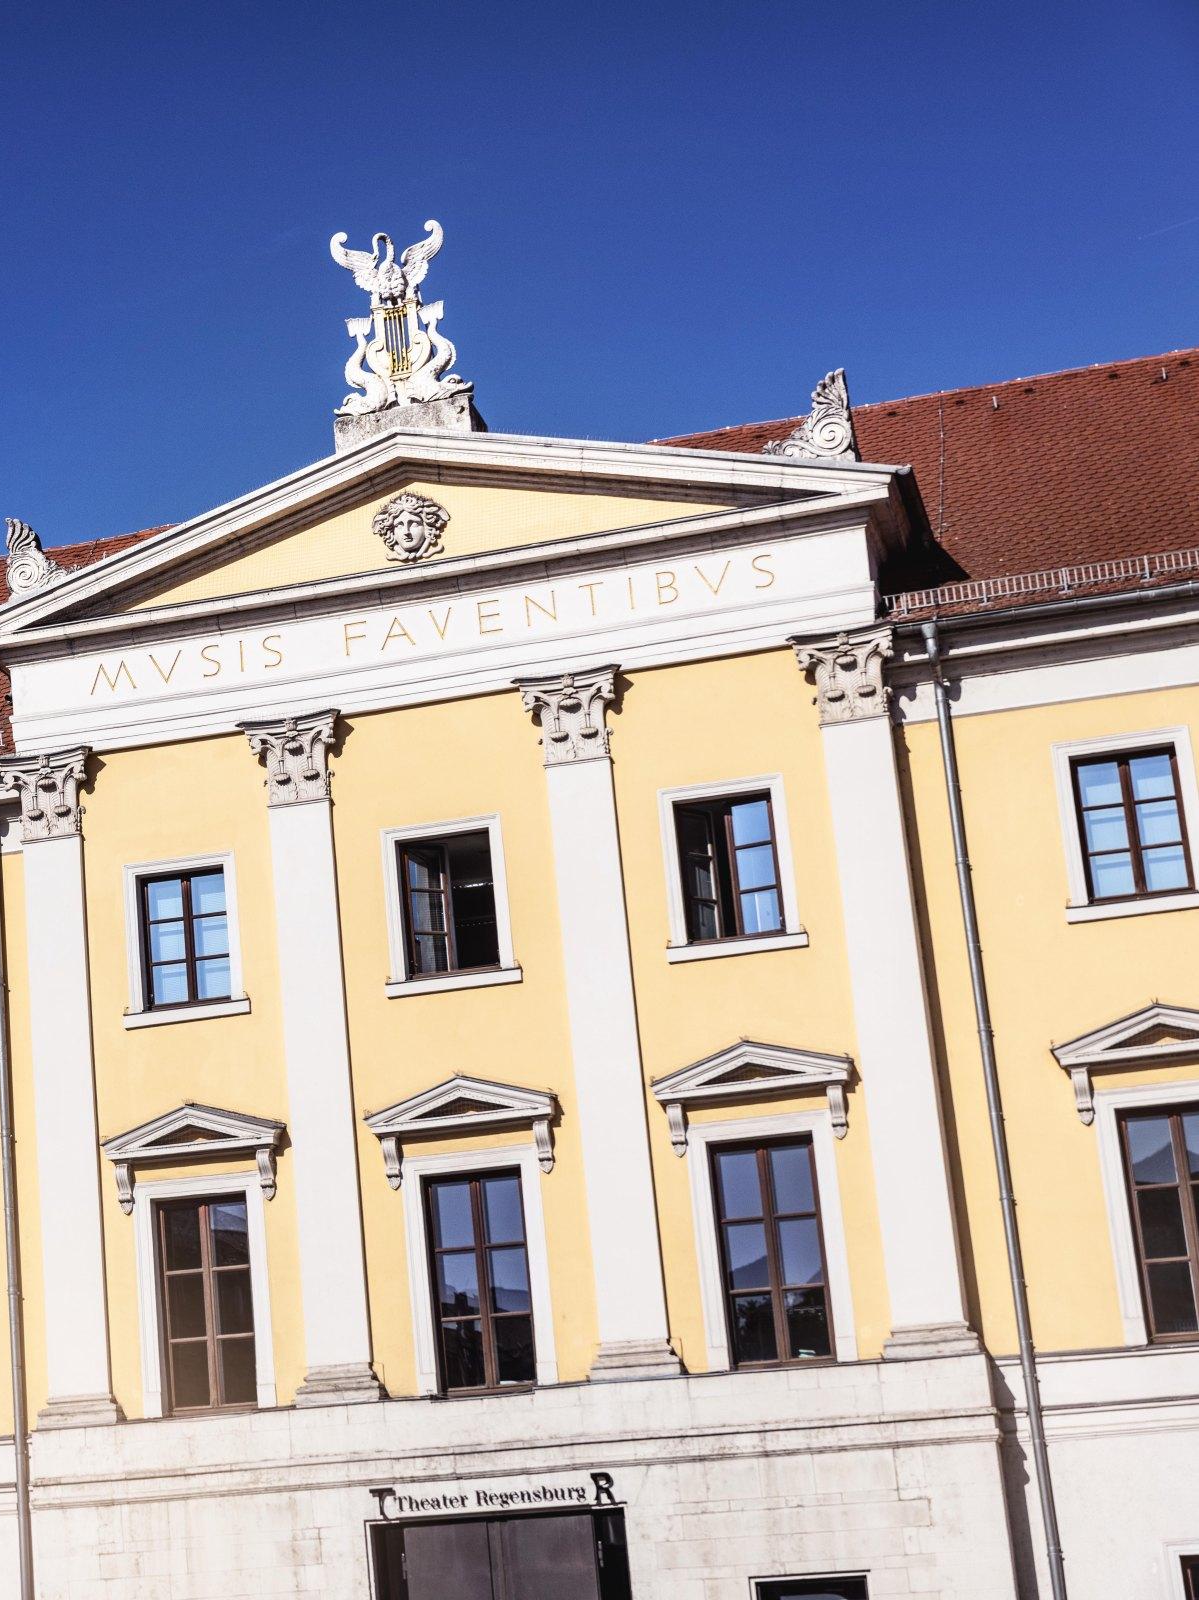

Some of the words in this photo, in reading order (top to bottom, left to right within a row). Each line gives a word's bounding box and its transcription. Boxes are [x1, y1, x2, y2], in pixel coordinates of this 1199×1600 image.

[91, 635, 283, 695] MVSIS
[344, 554, 776, 656] FAVENTIBVS
[394, 1491, 469, 1513] Theater
[474, 1484, 587, 1509] Regensburg
[589, 1471, 616, 1506] R
